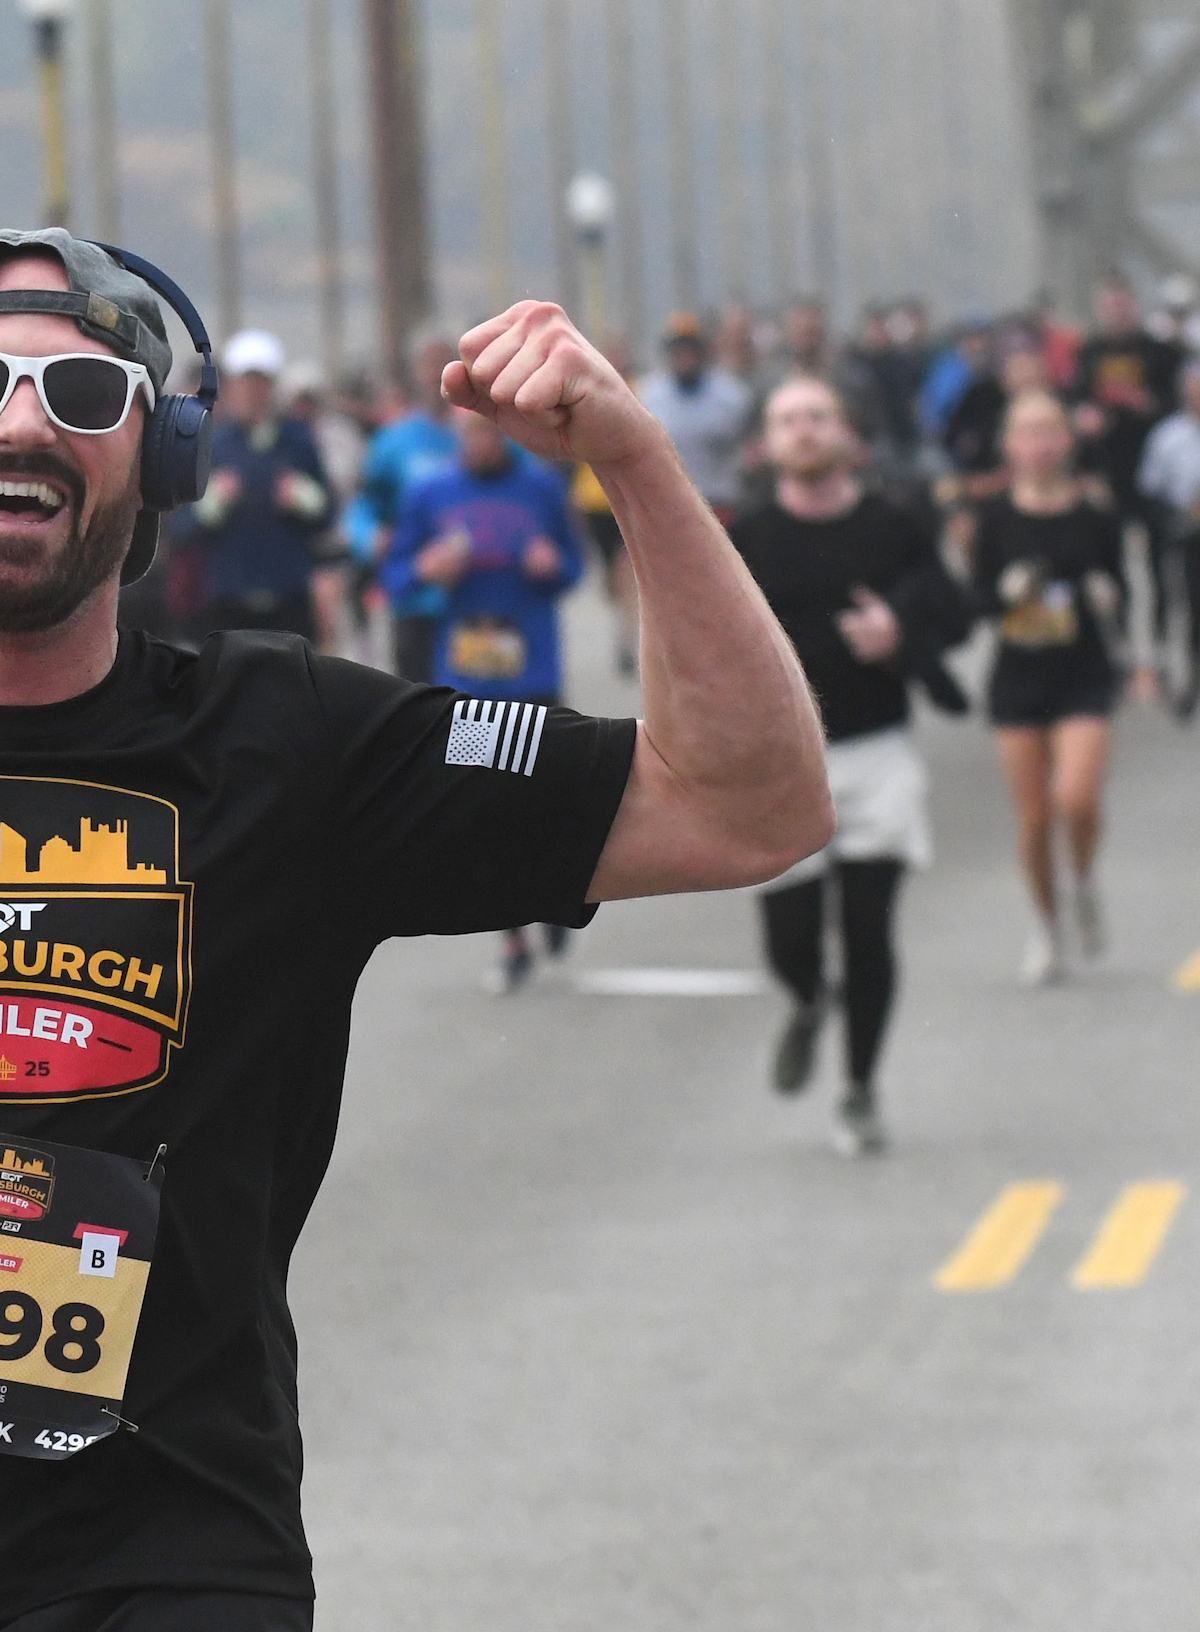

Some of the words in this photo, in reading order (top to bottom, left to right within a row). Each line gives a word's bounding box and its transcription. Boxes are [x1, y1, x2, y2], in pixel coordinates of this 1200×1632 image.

[25, 1060, 50, 1077] 25
[1, 1171, 23, 1182] EQT
[0, 1194, 29, 1209] MILER
[91, 1249, 105, 1269] B
